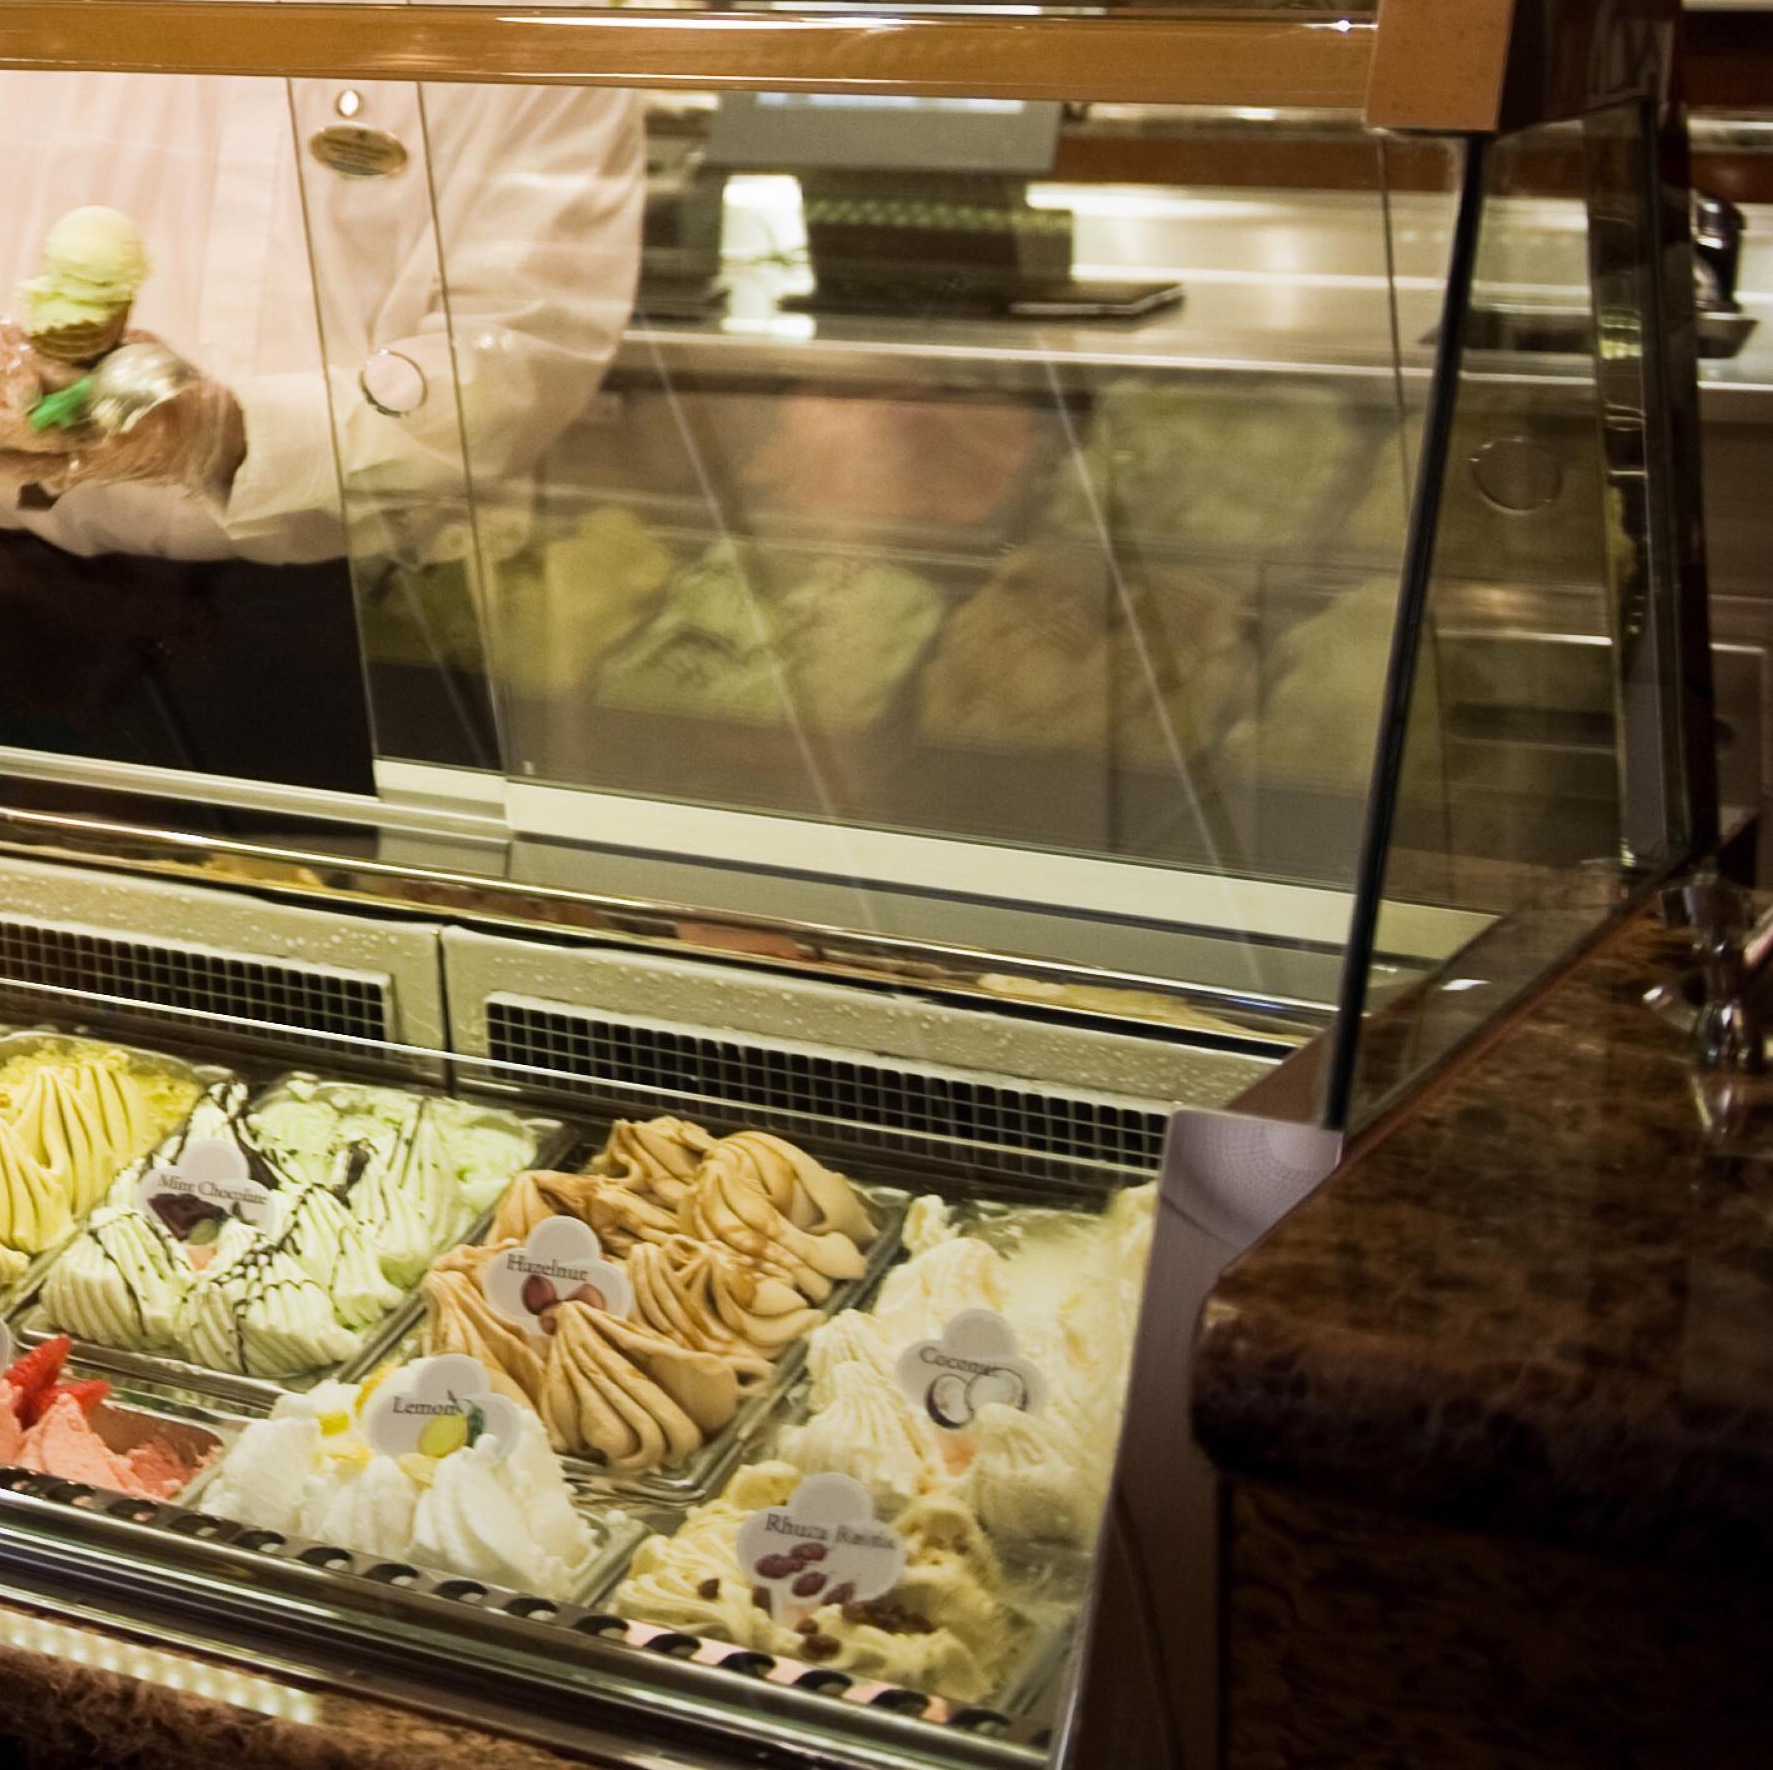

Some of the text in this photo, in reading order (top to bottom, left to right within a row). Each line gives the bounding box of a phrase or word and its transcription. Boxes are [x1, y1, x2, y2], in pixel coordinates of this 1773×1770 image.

[158, 1173, 268, 1206] Mint Chocolate
[506, 1253, 589, 1282] Hazelnut
[392, 1396, 457, 1416] Lemon
